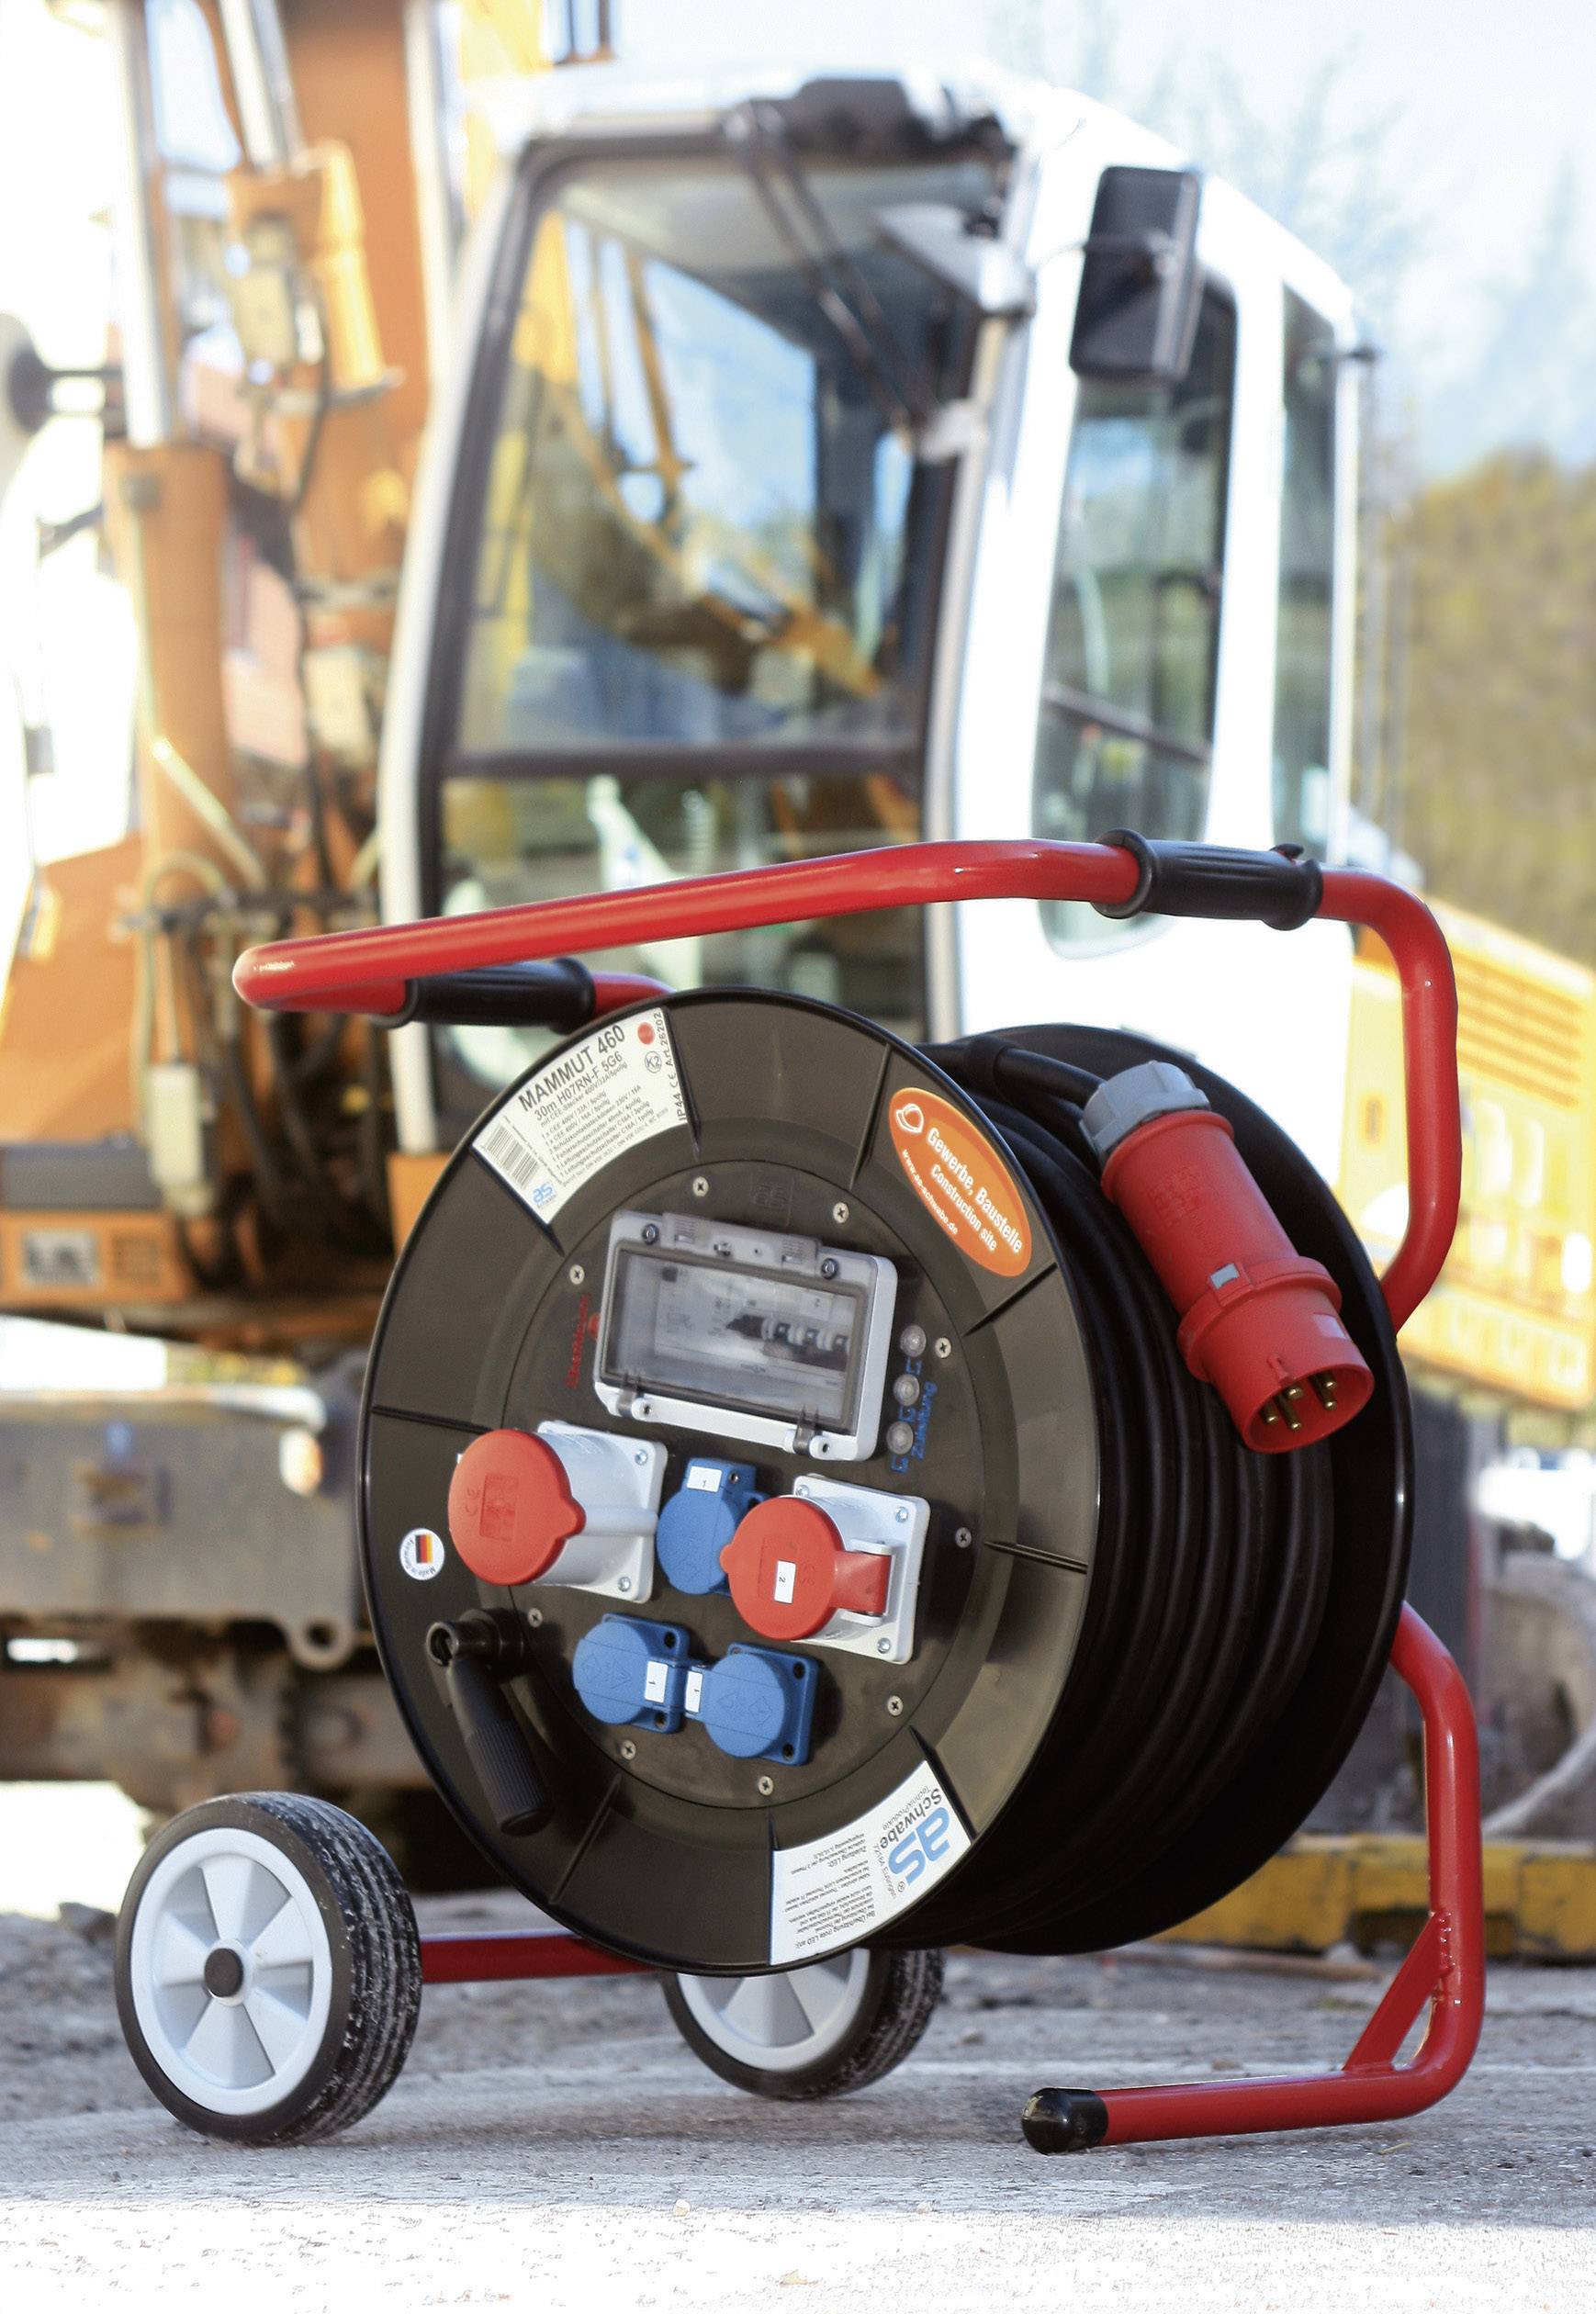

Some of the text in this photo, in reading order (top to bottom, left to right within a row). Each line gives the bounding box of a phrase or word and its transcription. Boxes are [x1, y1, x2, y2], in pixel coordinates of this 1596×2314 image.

[518, 1024, 626, 1113] MAMMUT 460
[534, 1050, 622, 1120] 30m H07RN-F 5G6
[673, 1093, 687, 1122] IP44
[531, 1182, 555, 1205] as
[902, 1149, 959, 1236] www.as-schwabe.de
[926, 1127, 1023, 1253] Gewerbe, Baustelle
[930, 1163, 997, 1252] Construction site
[880, 1788, 942, 1848] Schwabe
[882, 1785, 931, 1831] TechnikProdukte
[888, 1806, 950, 1886] as
